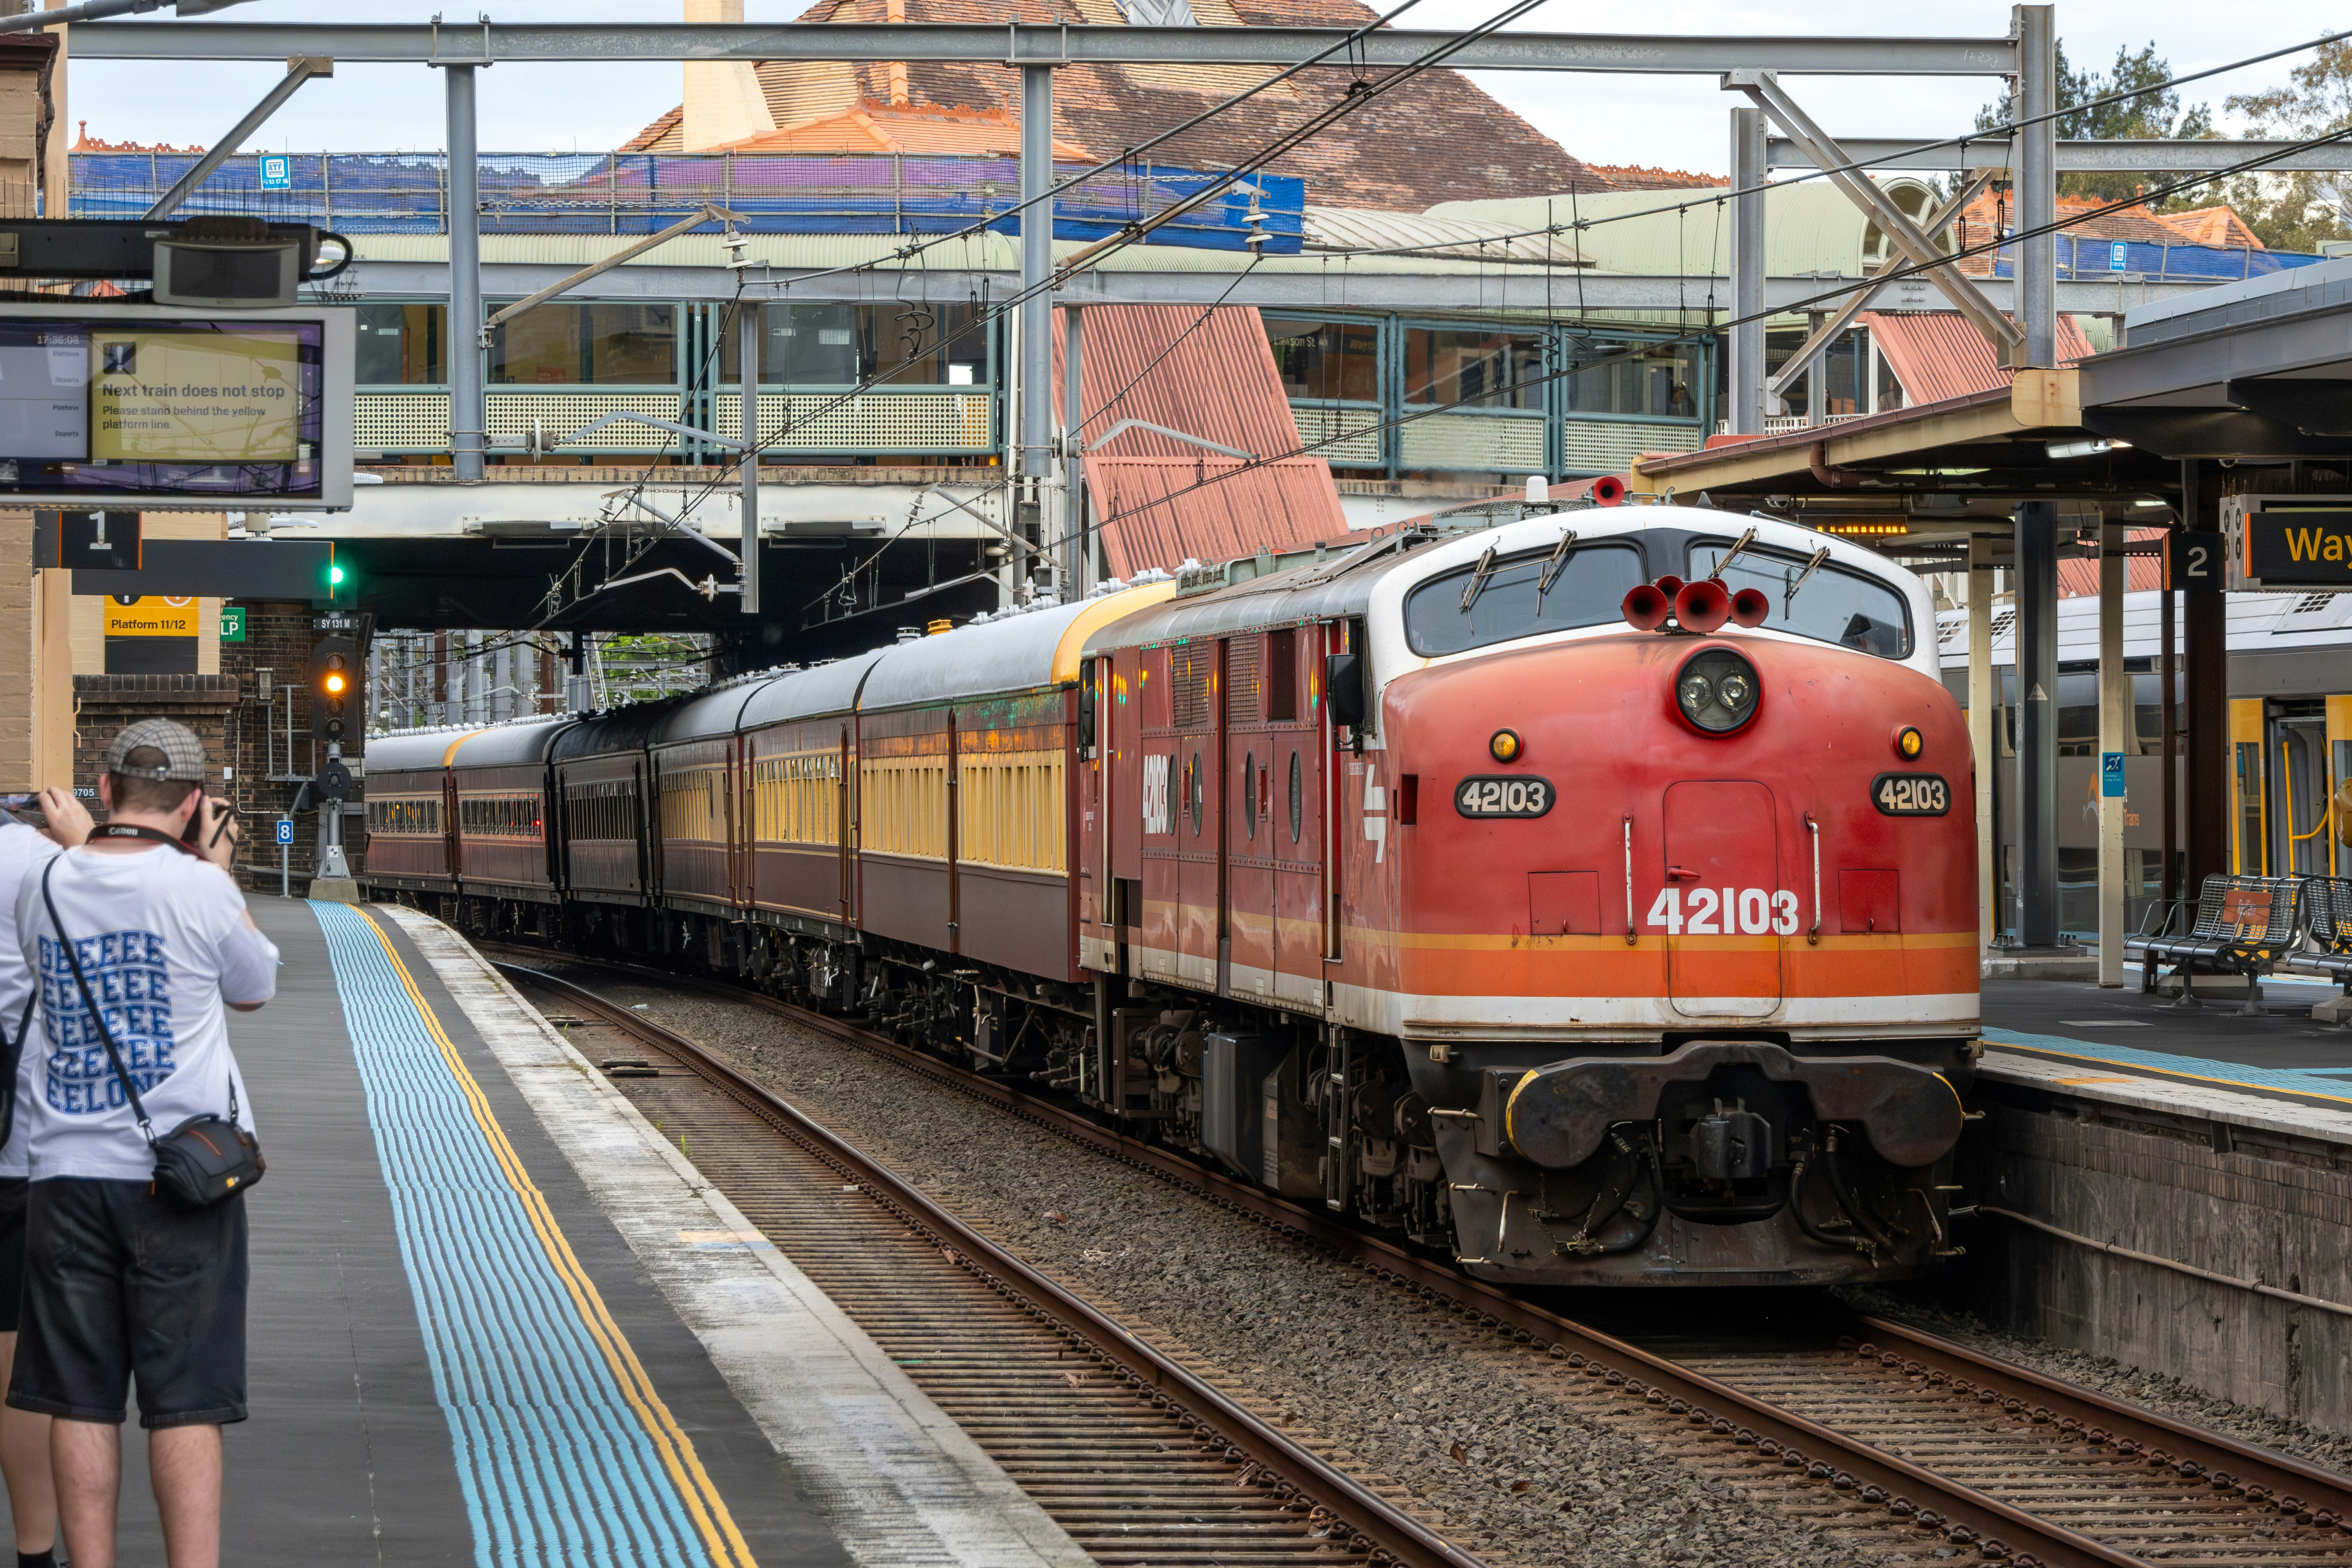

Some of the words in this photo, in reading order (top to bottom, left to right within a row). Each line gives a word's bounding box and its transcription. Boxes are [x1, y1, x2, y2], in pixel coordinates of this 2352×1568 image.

[1274, 334, 1305, 346] Lawson
[1306, 336, 1315, 347] St
[103, 384, 138, 397] Next
[143, 383, 178, 397] train
[182, 383, 218, 397] does
[222, 384, 247, 397] not
[252, 384, 285, 399] stop
[103, 406, 138, 416] Please
[141, 406, 170, 416] stand
[174, 406, 209, 416] behind
[212, 406, 229, 416] the
[232, 406, 266, 417] yellow
[103, 419, 148, 431] platform
[89, 511, 112, 549] 1
[2187, 546, 2207, 576] 2
[112, 619, 158, 629] Platform
[160, 620, 186, 630] 11/12
[322, 619, 331, 628] SY
[332, 619, 342, 628] 131
[344, 619, 350, 628] M
[1142, 754, 1168, 834] 42103
[1462, 782, 1545, 812] 42103
[1880, 780, 1945, 810] 42103
[2123, 808, 2140, 827] Trains
[109, 827, 139, 835] Canon
[280, 825, 290, 840] 8
[1647, 887, 1798, 935] 42103
